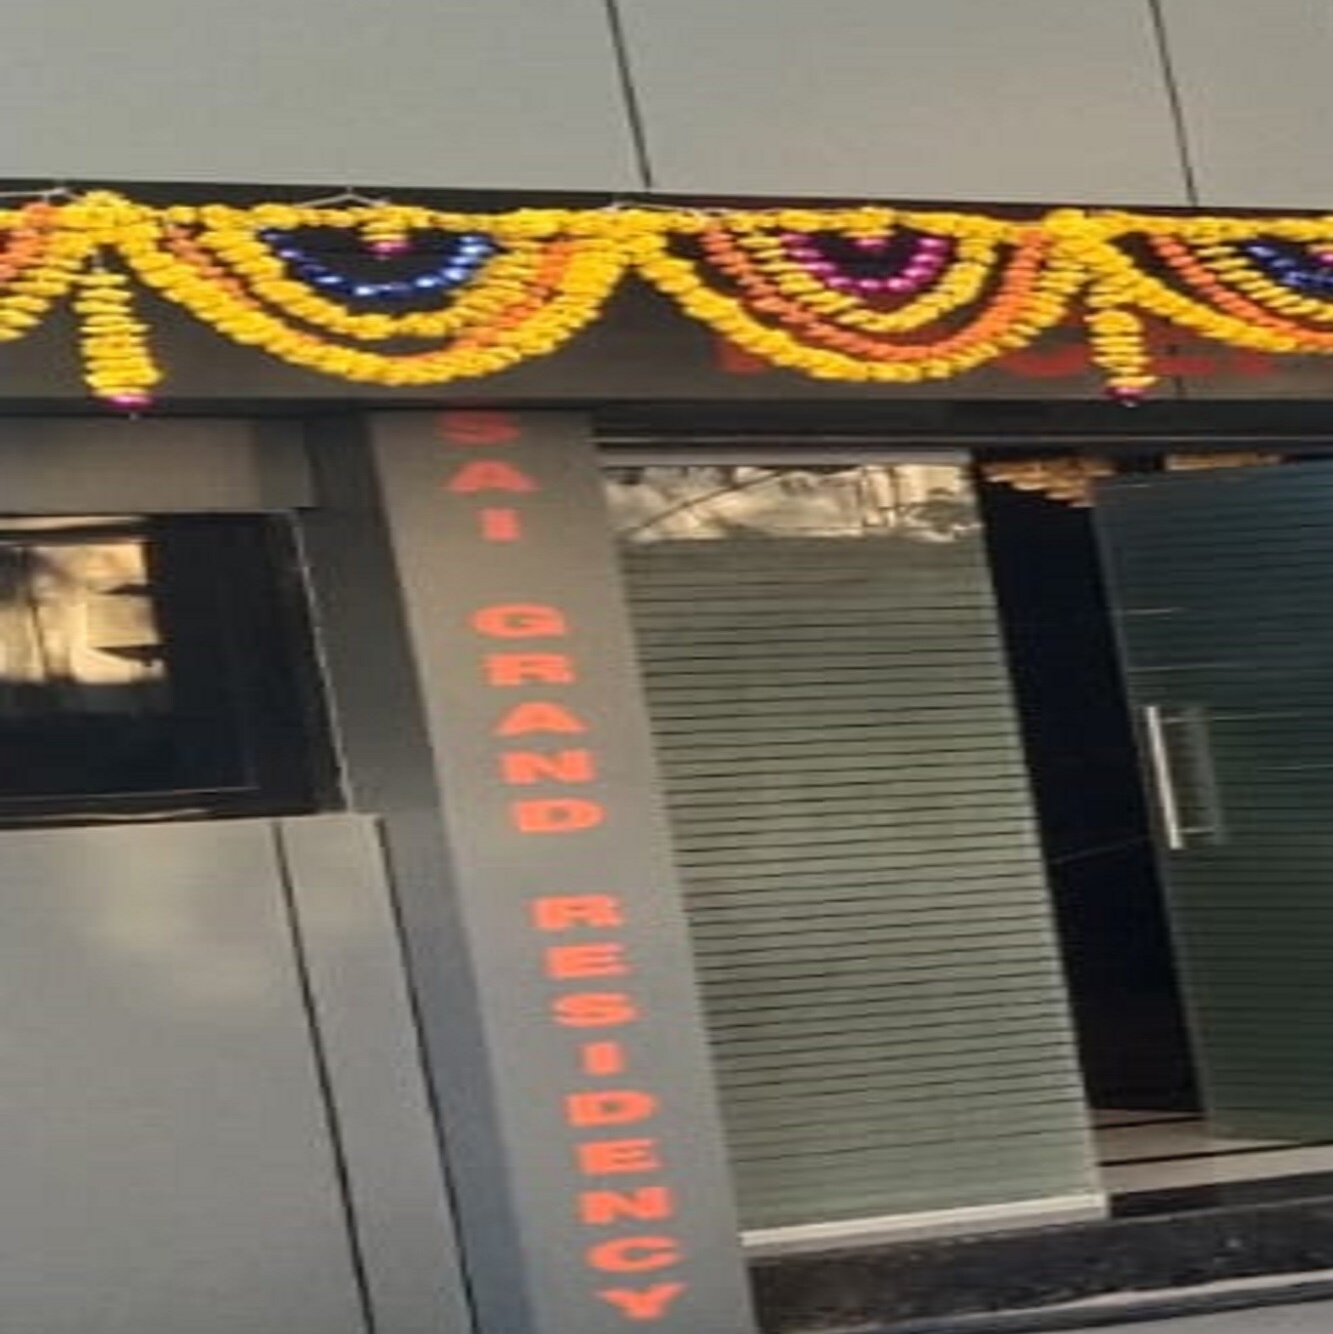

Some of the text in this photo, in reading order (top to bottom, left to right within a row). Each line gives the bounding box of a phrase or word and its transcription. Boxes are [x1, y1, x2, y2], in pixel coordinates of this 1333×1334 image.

[437, 411, 688, 1321] SAI GRAND RESIDENCY
